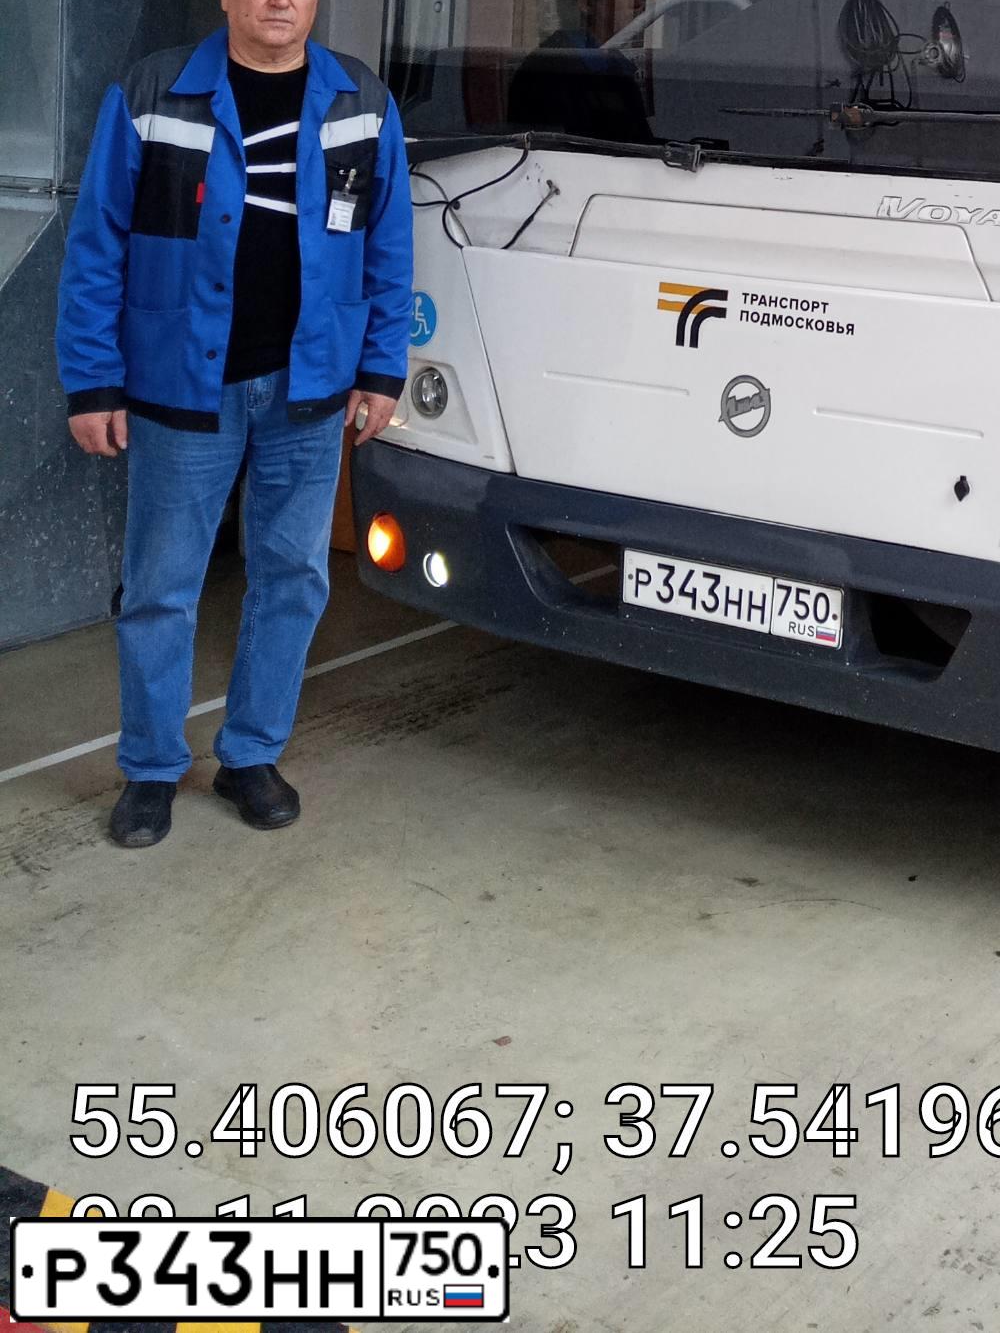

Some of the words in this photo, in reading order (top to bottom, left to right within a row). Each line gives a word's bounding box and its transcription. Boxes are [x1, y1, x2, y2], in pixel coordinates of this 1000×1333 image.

[741, 292, 829, 315] ТРАНСПОРТ
[739, 310, 855, 336] ПОДМОСКОВЬЯ
[776, 583, 831, 624] 750
[788, 621, 815, 638] RUS
